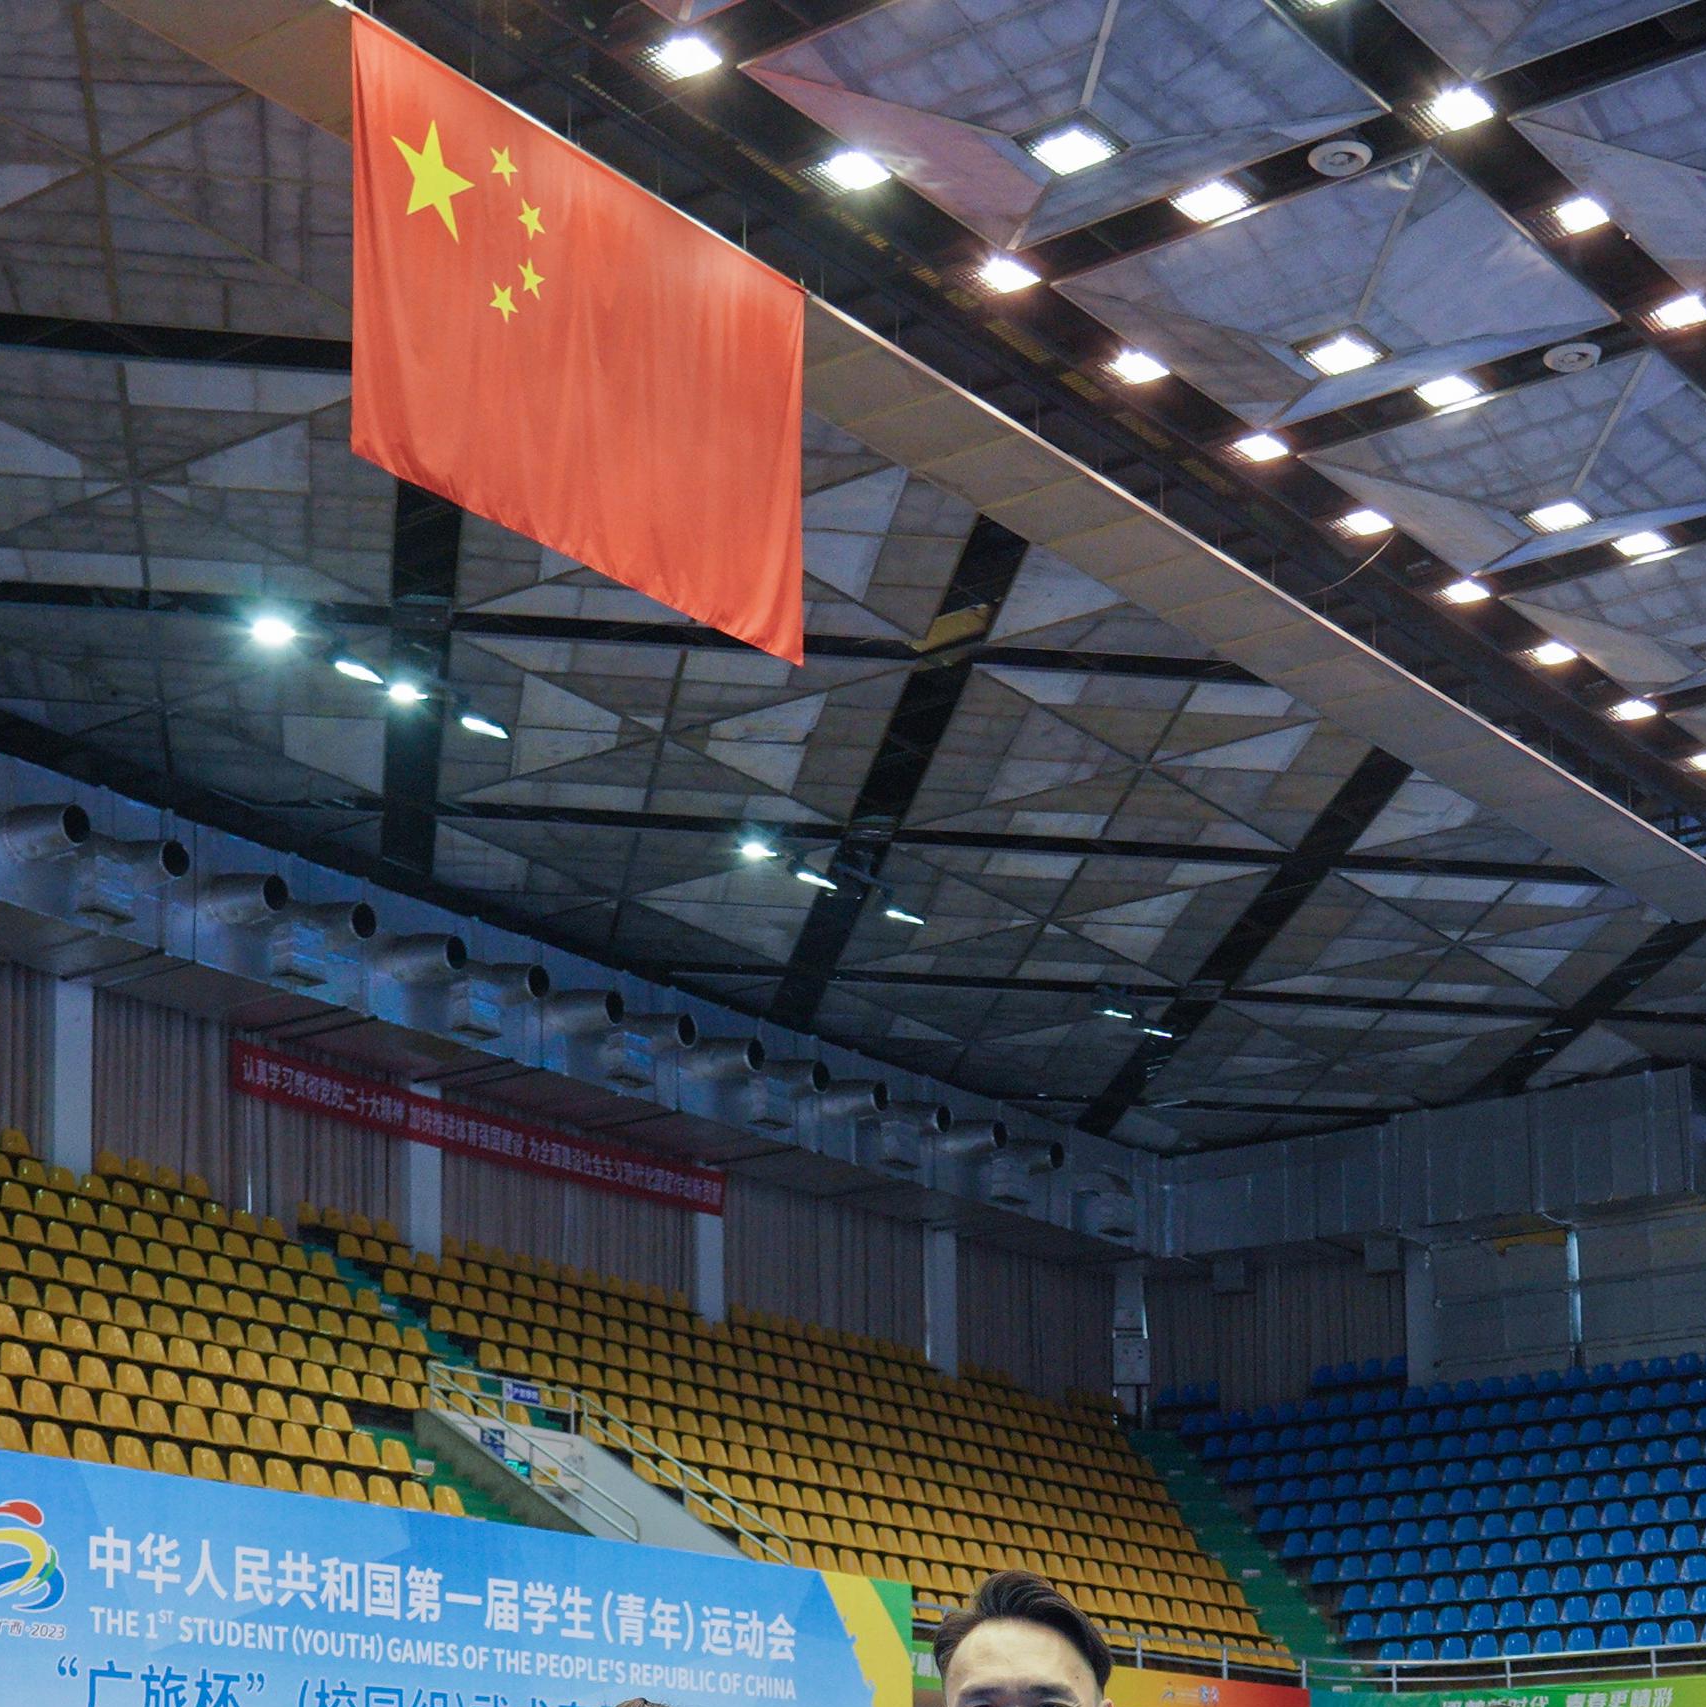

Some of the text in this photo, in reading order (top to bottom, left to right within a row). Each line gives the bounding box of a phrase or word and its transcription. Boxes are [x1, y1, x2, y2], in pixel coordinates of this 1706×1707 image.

[89, 1527, 797, 1662] 中华人民共和国第一届学生(青年)运动会
[90, 1606, 797, 1700] THE 1ST STUDENT (YOUTH) GAMES OF THE PEOPLE'S REPUBLIC OF CHINA
